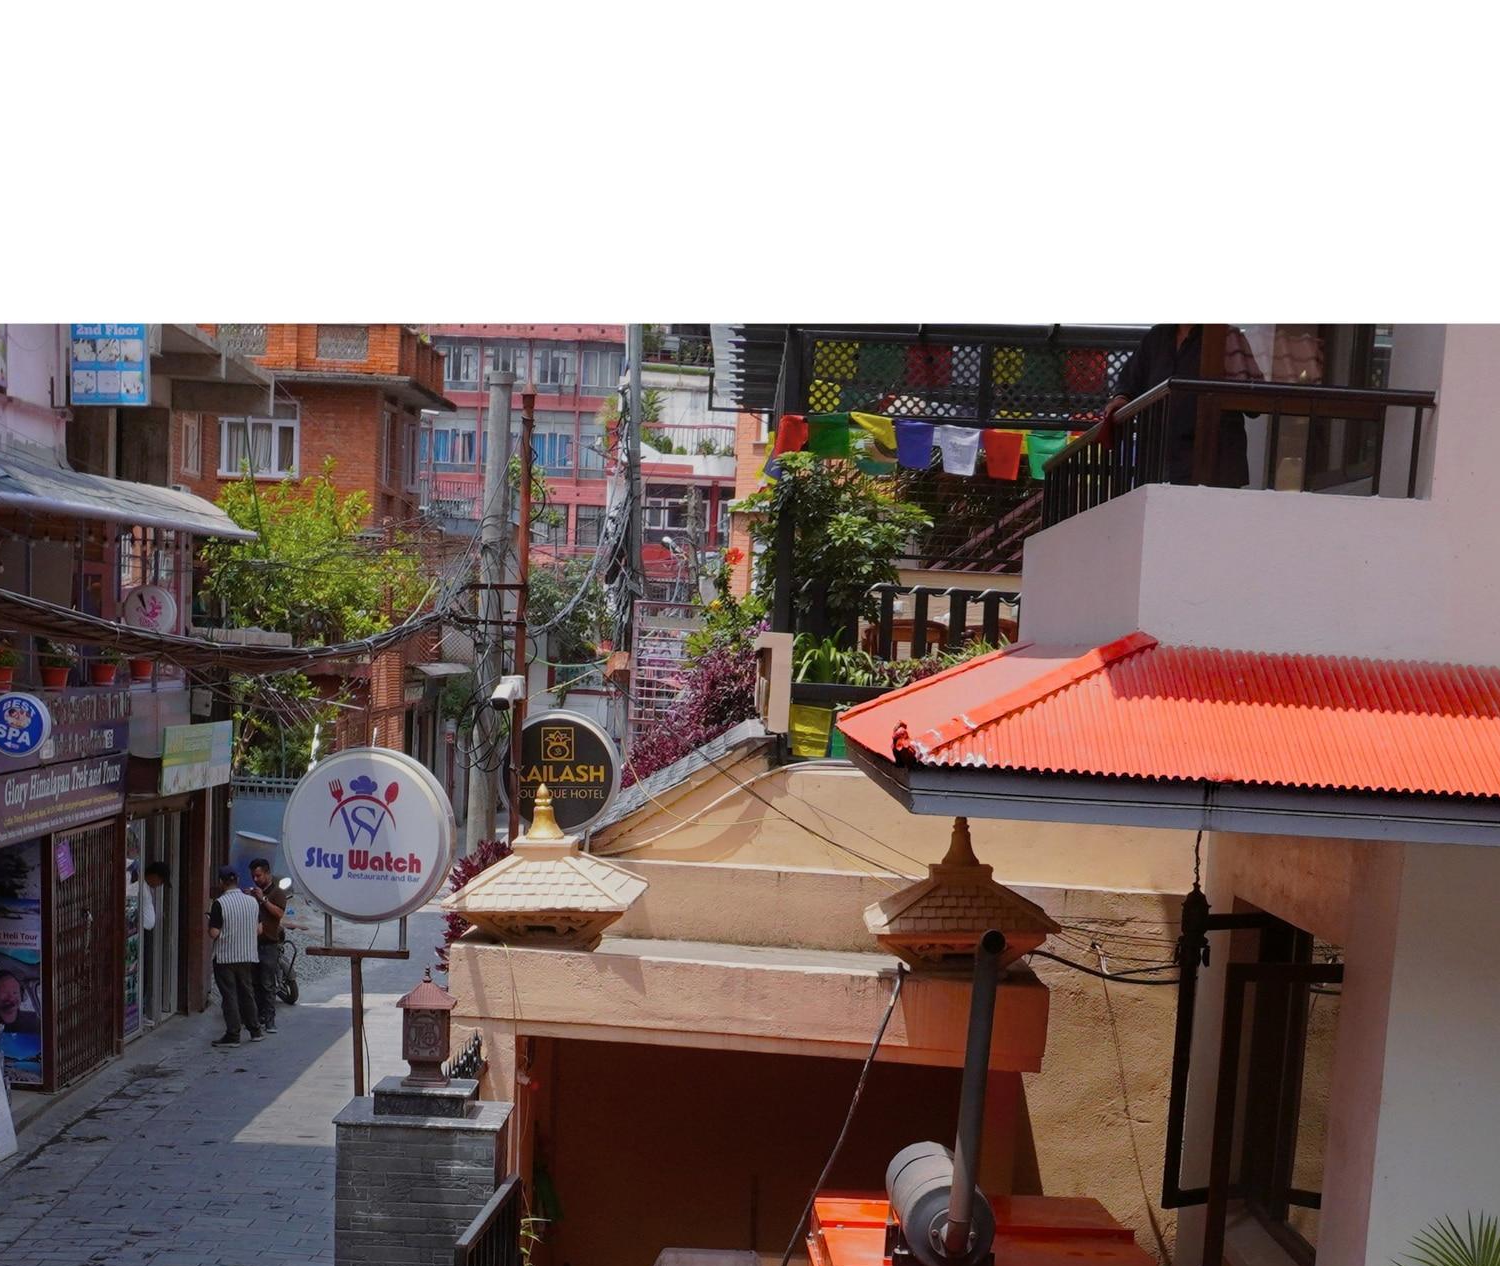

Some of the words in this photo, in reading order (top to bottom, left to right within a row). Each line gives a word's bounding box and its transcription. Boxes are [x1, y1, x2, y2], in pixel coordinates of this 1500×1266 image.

[2, 698, 37, 718] BEST
[4, 778, 29, 810] Glory
[29, 770, 70, 802] Himalayan
[71, 765, 88, 791] Trek
[88, 761, 102, 787] and
[101, 760, 121, 785] Tours
[570, 788, 605, 799] HOTEL
[305, 847, 344, 880] Sky
[348, 849, 422, 874] Watch
[348, 872, 389, 882] Restaurant
[391, 874, 406, 882] and
[407, 874, 421, 883] Bar
[20, 932, 38, 940] Tour
